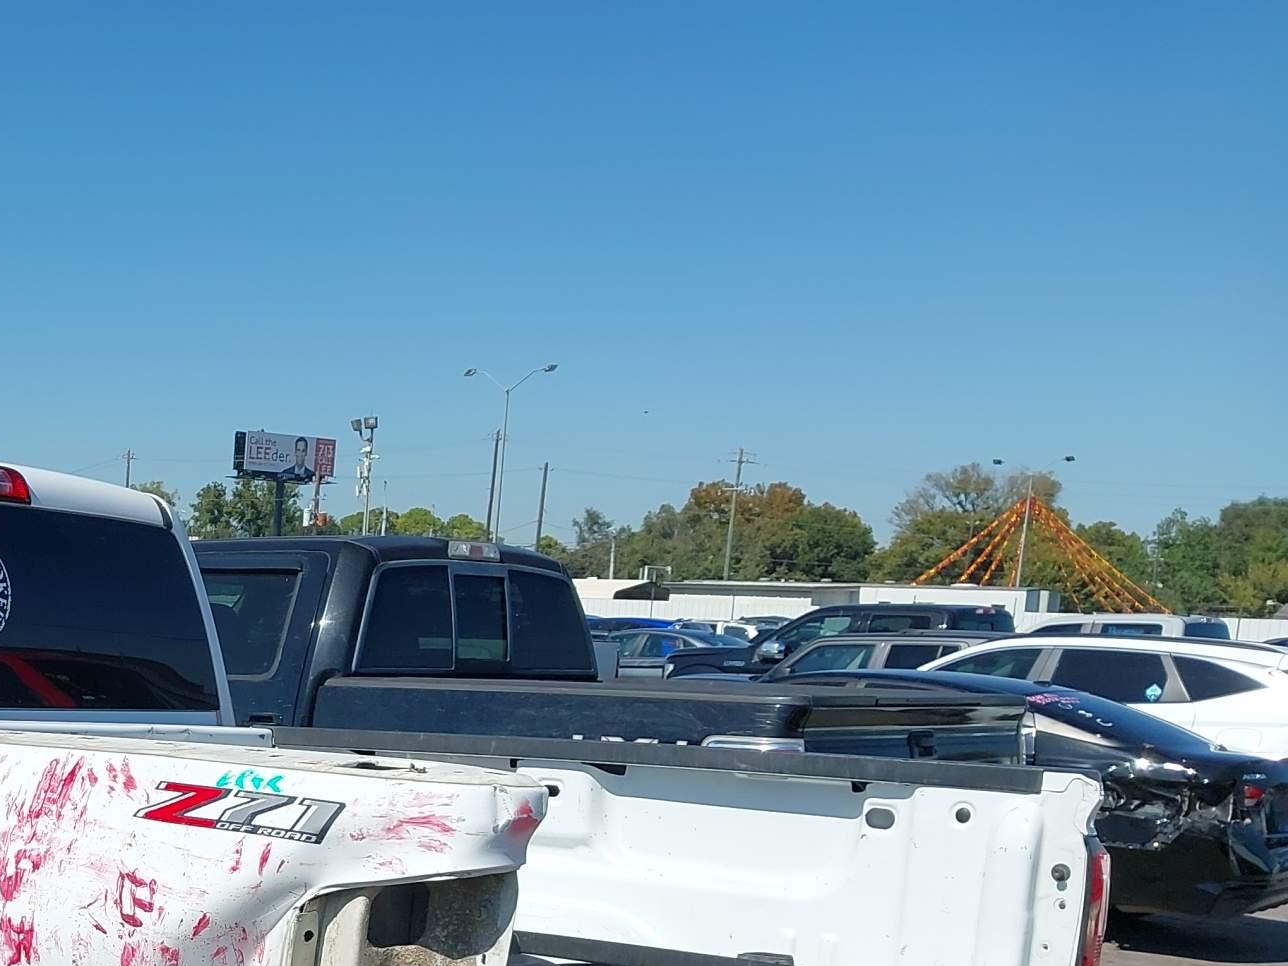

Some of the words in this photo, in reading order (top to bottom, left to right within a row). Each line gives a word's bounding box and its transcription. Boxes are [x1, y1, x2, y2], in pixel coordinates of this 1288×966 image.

[249, 436, 263, 446] Call
[319, 444, 333, 457] 713
[133, 780, 347, 845] Z71
[215, 821, 254, 833] OFF
[256, 826, 319, 844] ROAD
